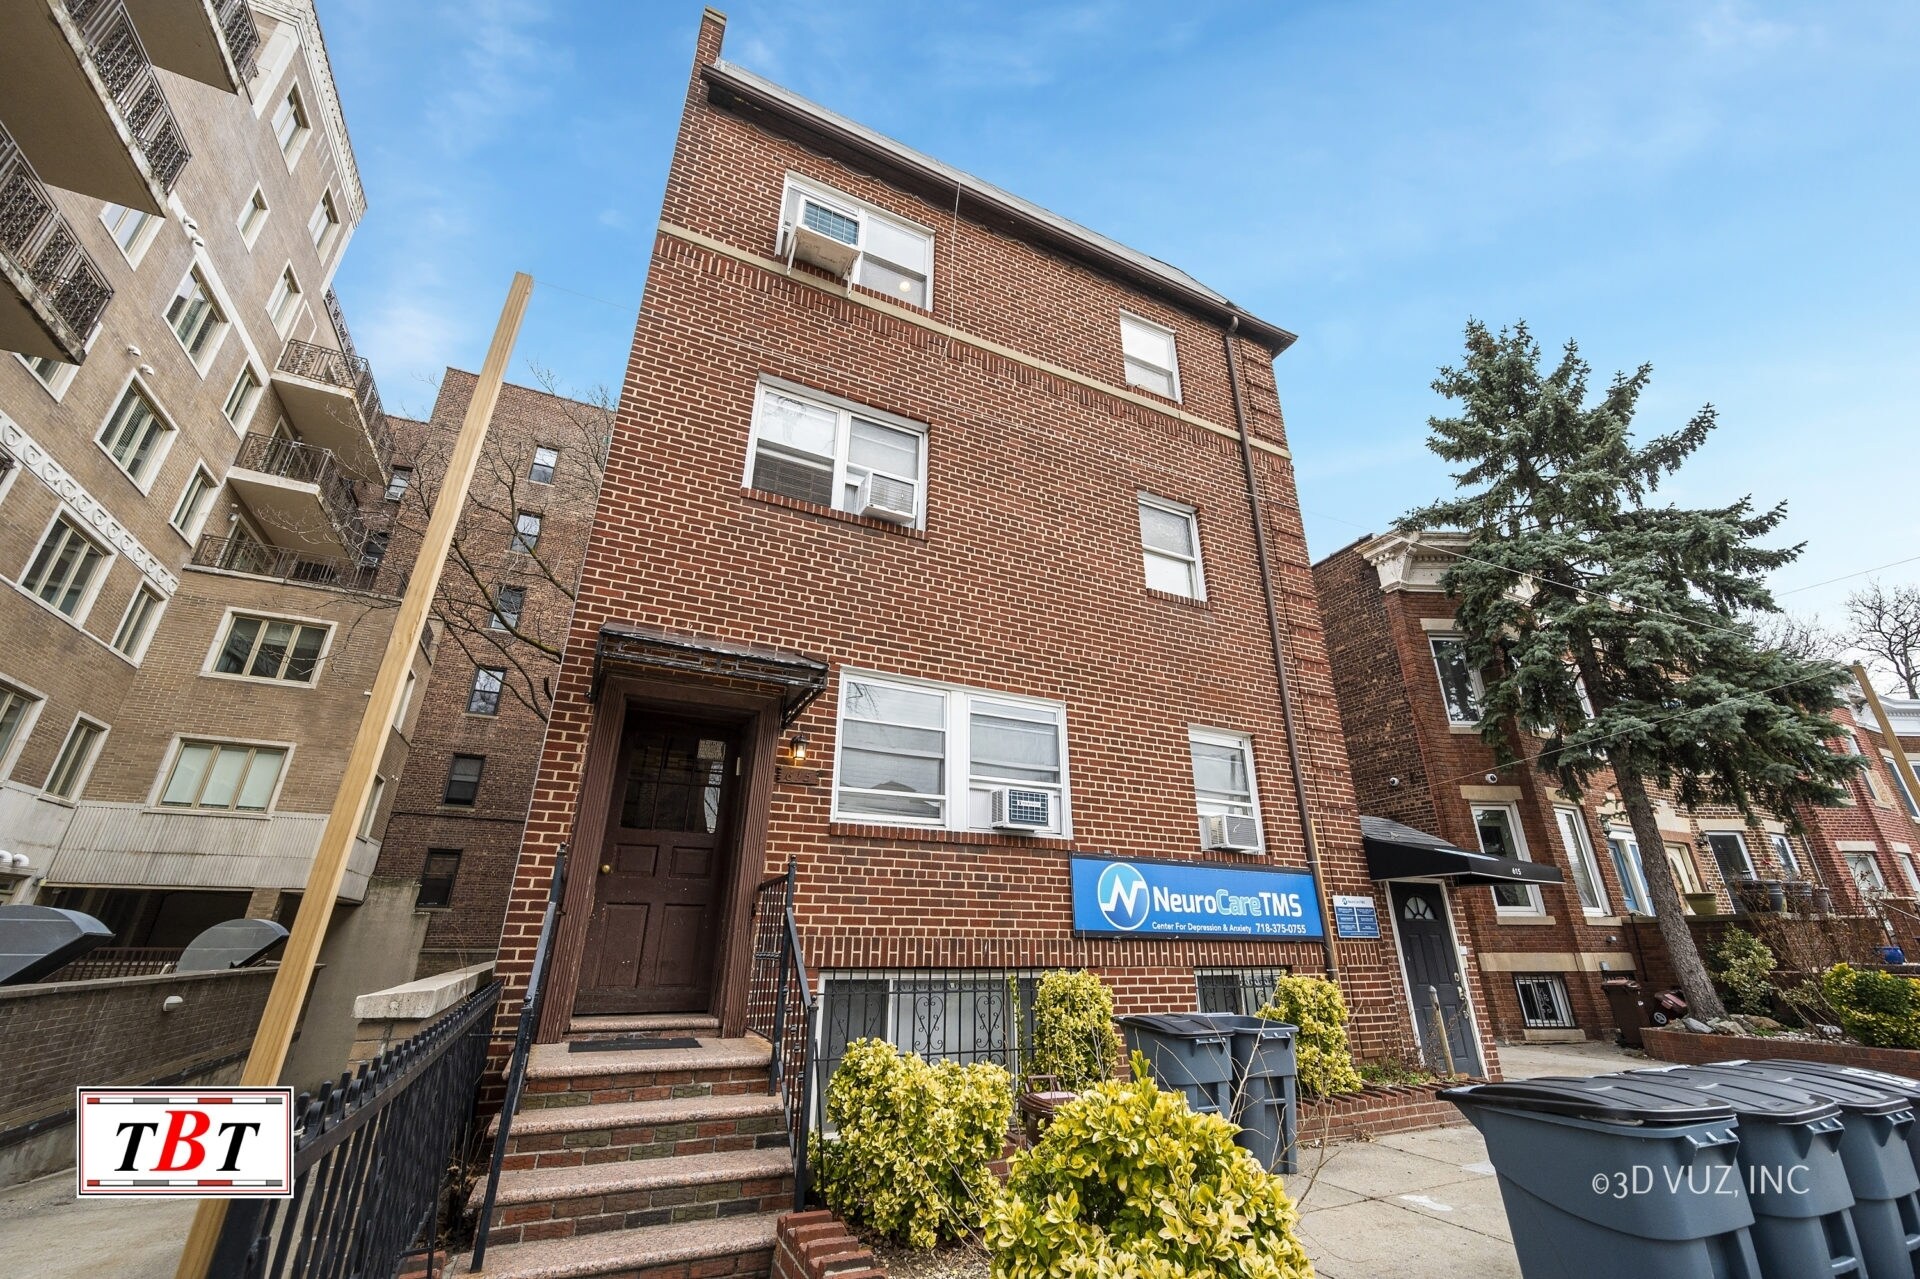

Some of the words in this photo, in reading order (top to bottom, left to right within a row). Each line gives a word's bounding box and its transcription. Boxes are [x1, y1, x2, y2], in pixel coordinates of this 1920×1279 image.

[1511, 867, 1522, 875] 615
[1152, 886, 1303, 918] NeuroCareTMS
[1152, 921, 1174, 930] Center
[1175, 922, 1187, 930] For
[1187, 923, 1222, 932] Depression
[1223, 924, 1229, 932] &
[1229, 924, 1252, 934] Anxiety
[1255, 922, 1307, 934] 718-375-0755
